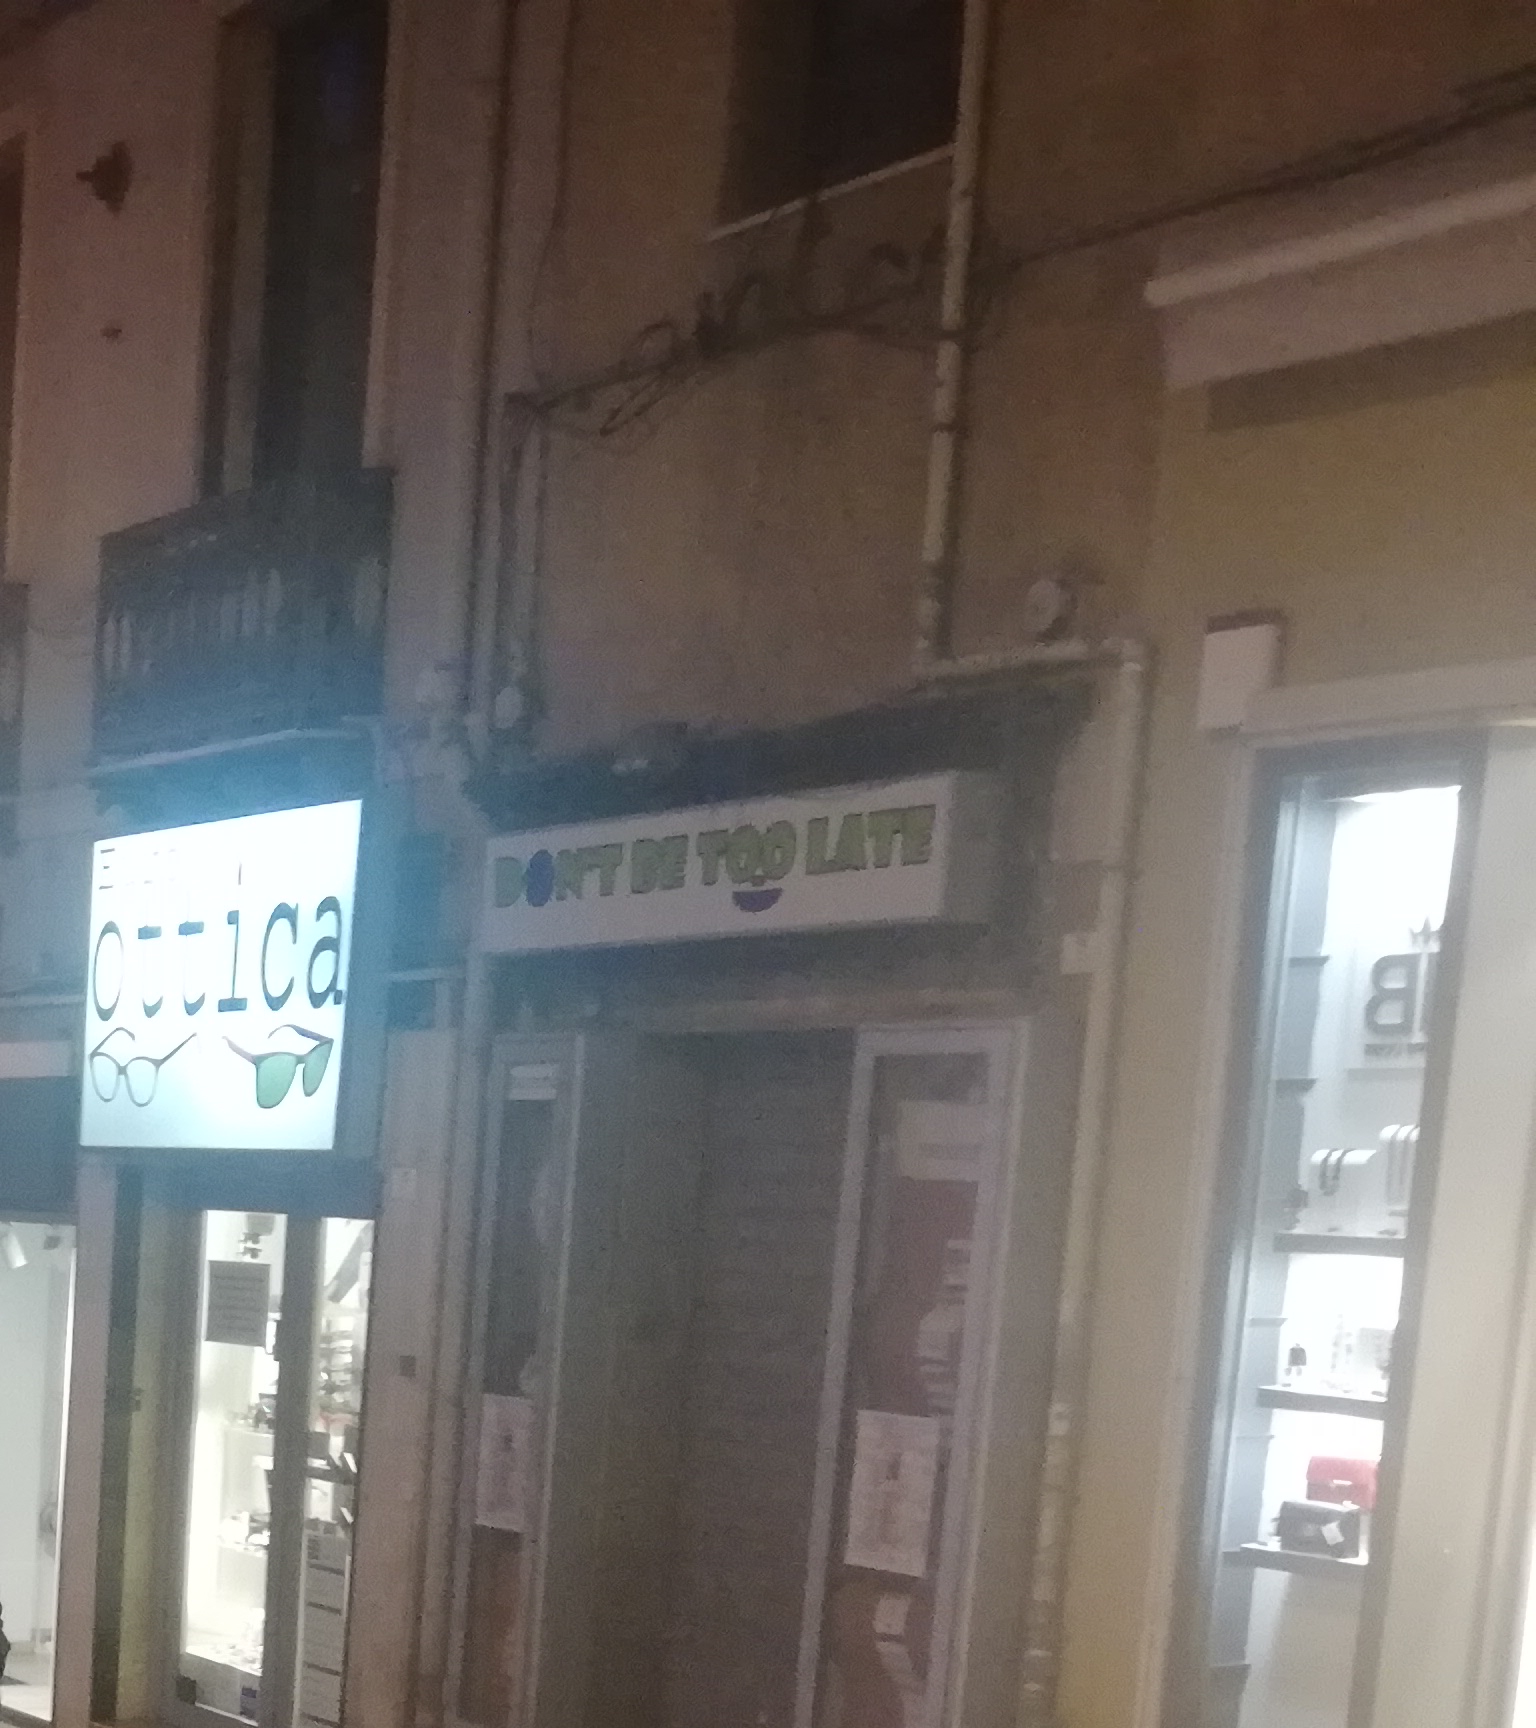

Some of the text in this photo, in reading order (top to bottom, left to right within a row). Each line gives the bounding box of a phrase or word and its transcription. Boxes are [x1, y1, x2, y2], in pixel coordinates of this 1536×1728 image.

[494, 804, 937, 908] DON'T BE TOO LATE
